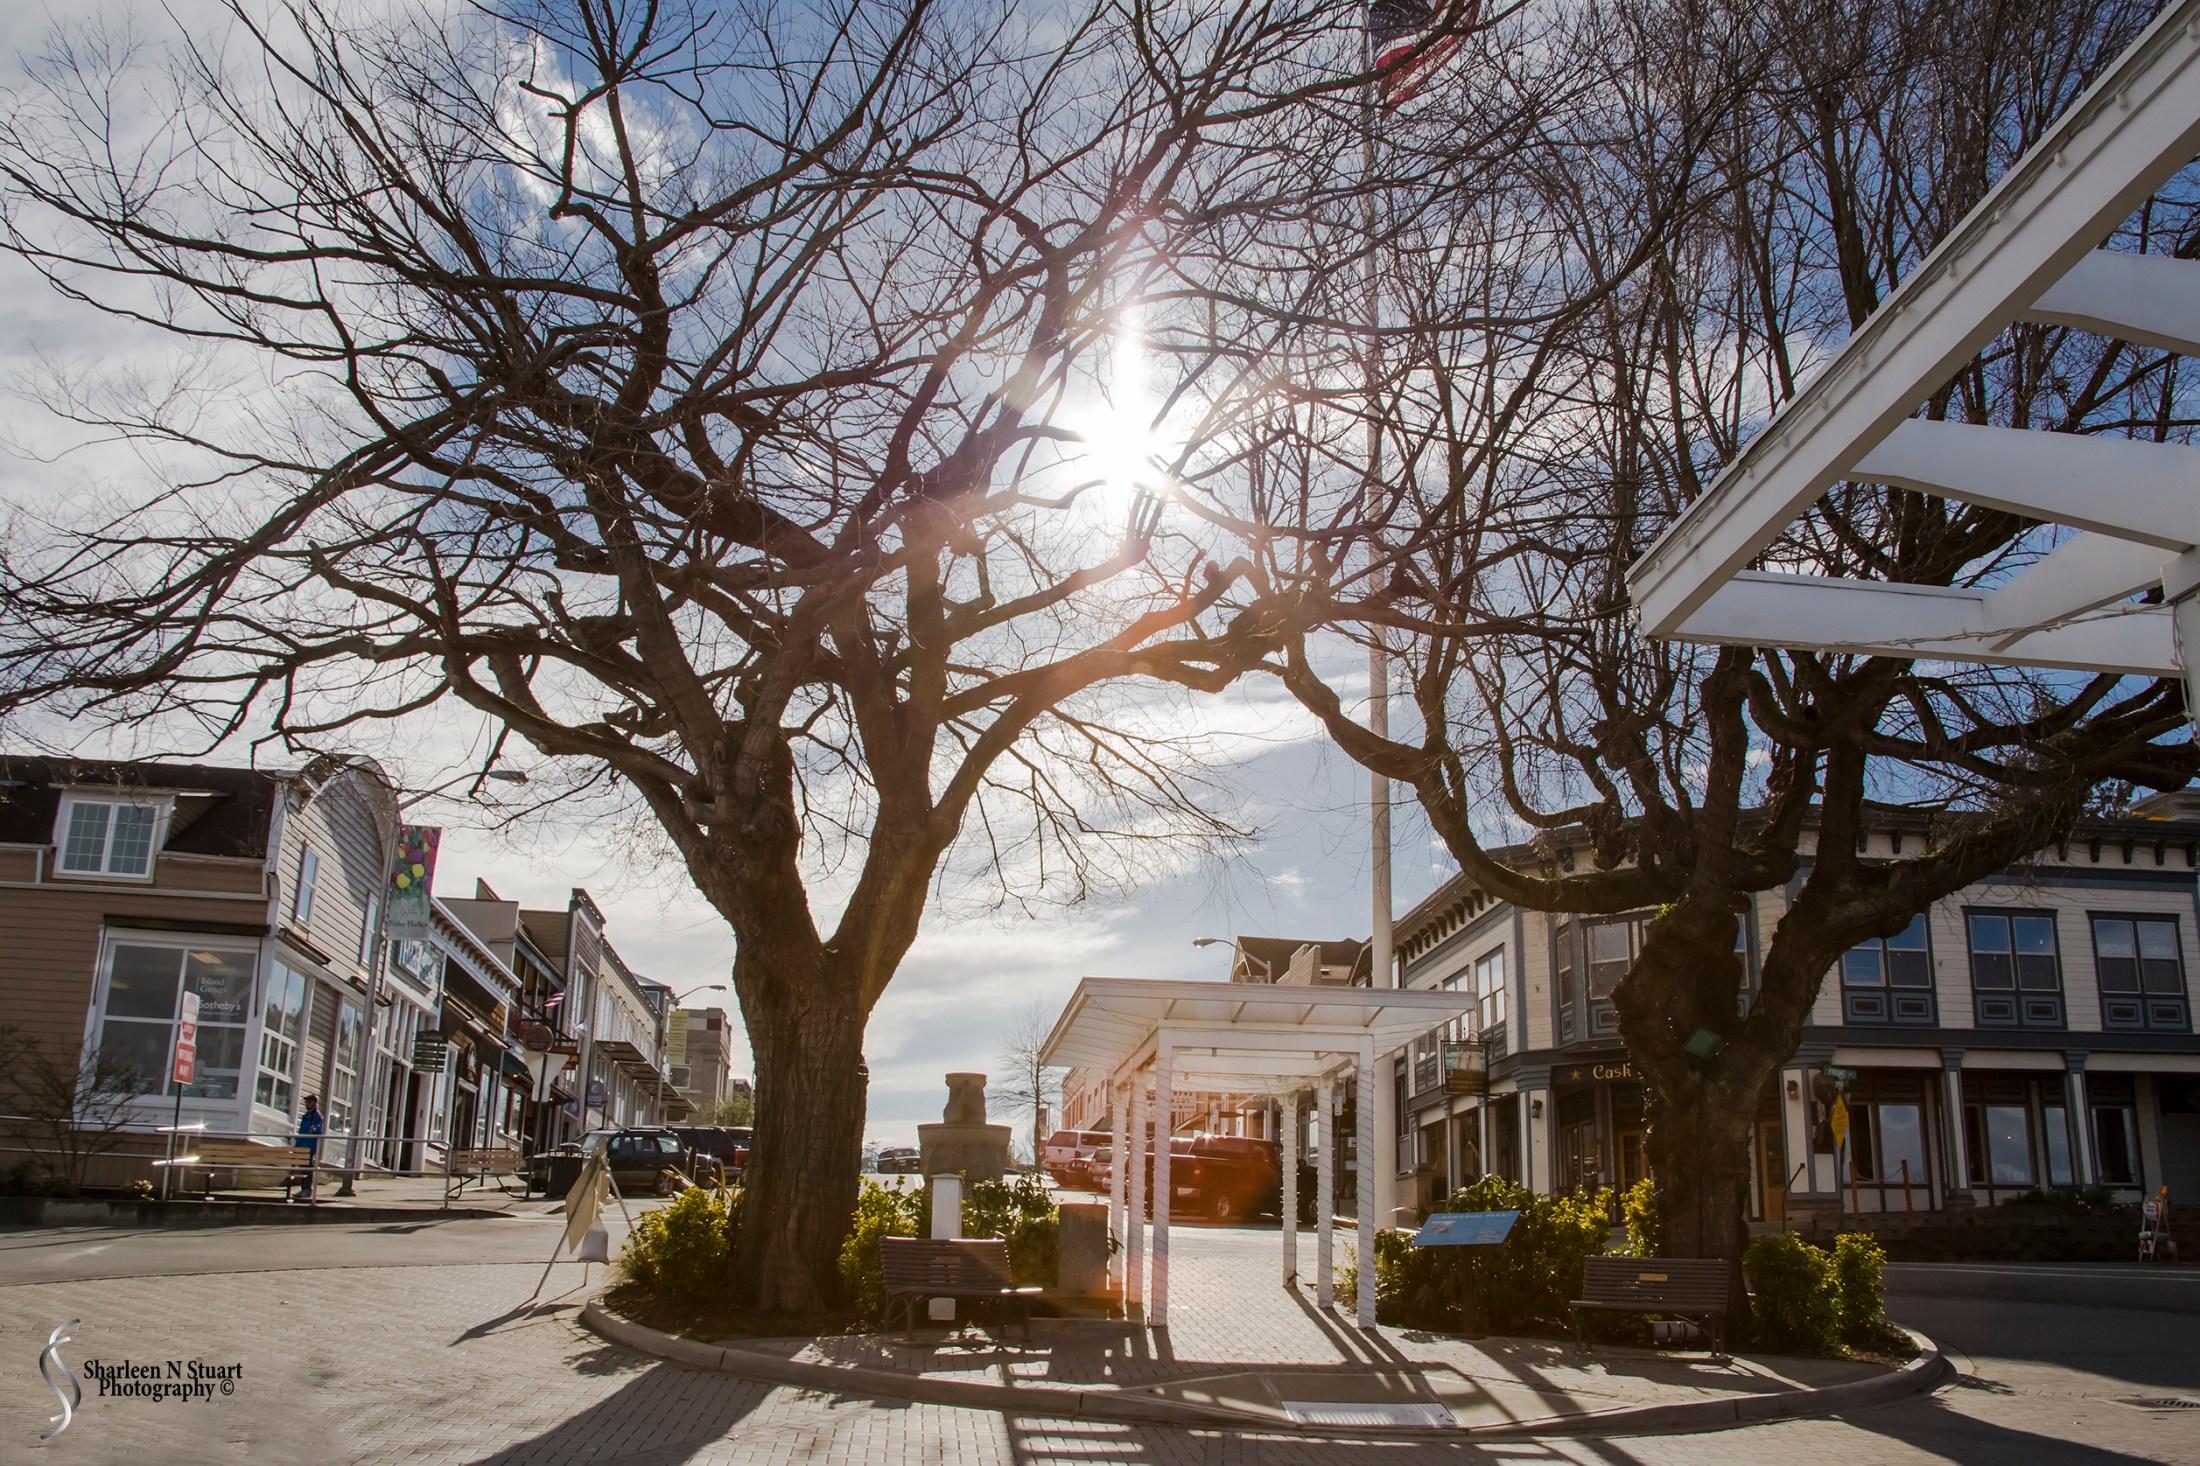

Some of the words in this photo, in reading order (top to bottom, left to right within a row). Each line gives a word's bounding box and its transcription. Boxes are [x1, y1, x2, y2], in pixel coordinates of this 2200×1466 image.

[201, 977, 225, 985] Island
[200, 985, 226, 995] Group
[1592, 1064, 1631, 1079] Cask
